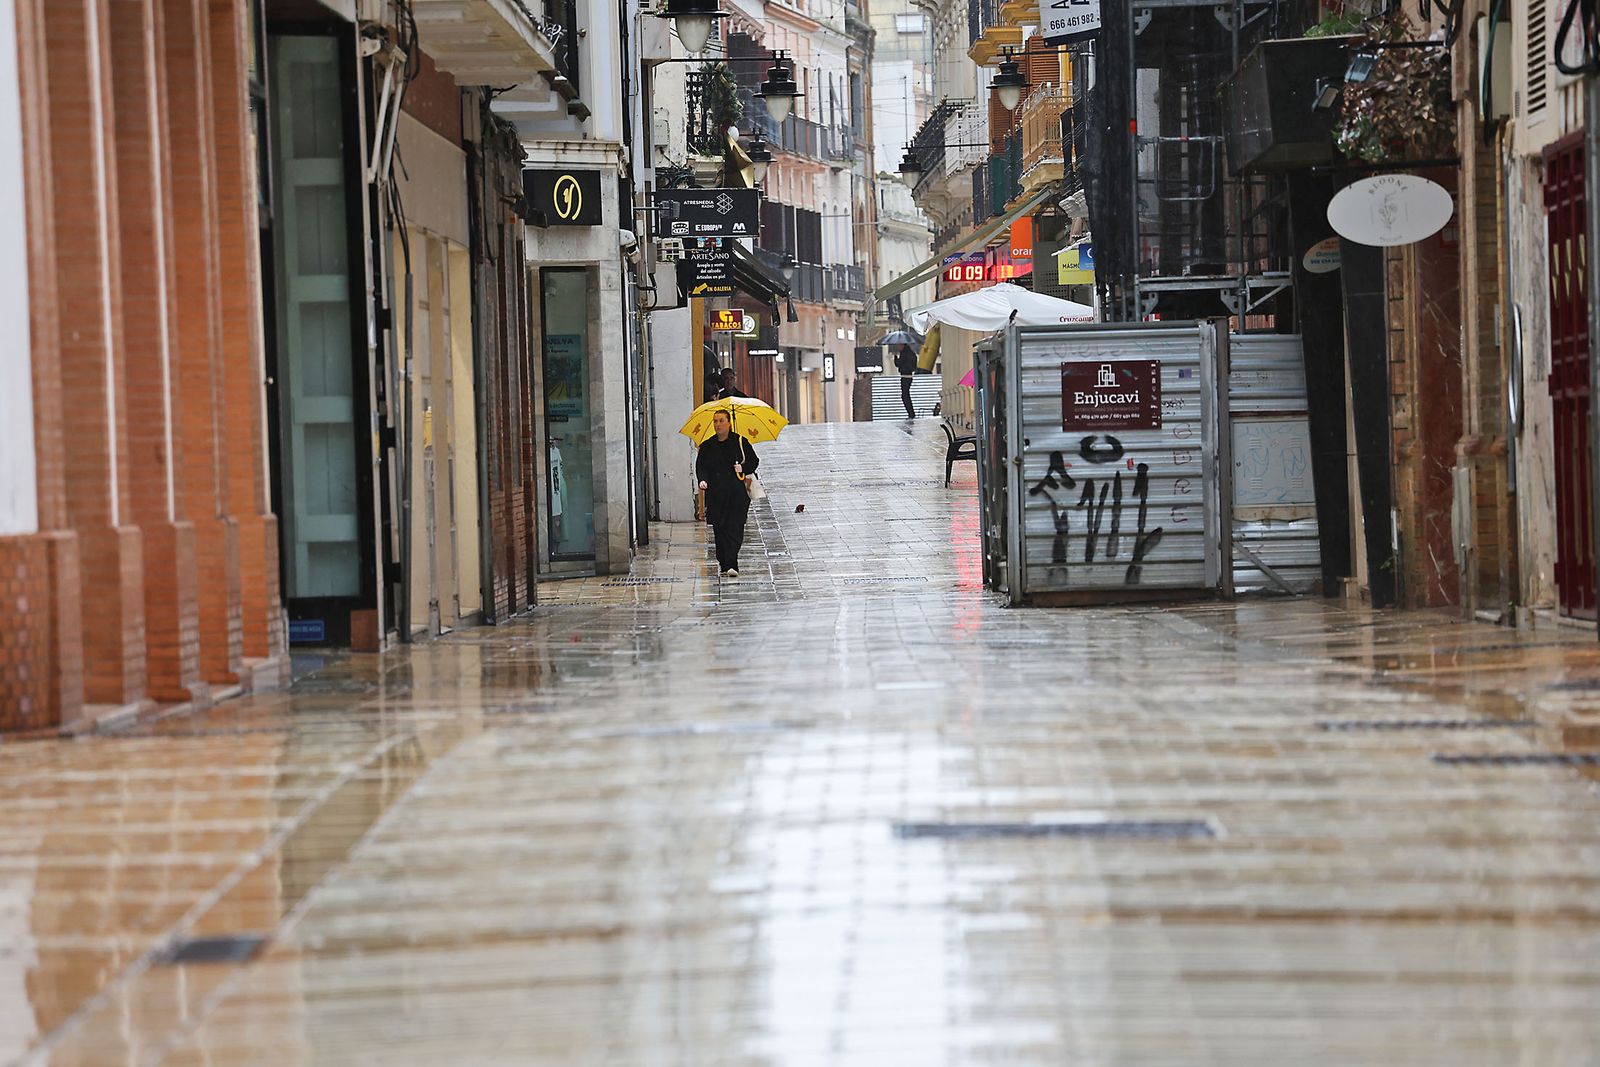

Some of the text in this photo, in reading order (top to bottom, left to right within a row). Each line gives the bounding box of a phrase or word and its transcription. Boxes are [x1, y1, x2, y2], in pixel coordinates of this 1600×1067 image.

[1050, 13, 1094, 30] 666 461 982
[949, 266, 983, 280] 10 09
[1074, 390, 1140, 407] Enjucavi
